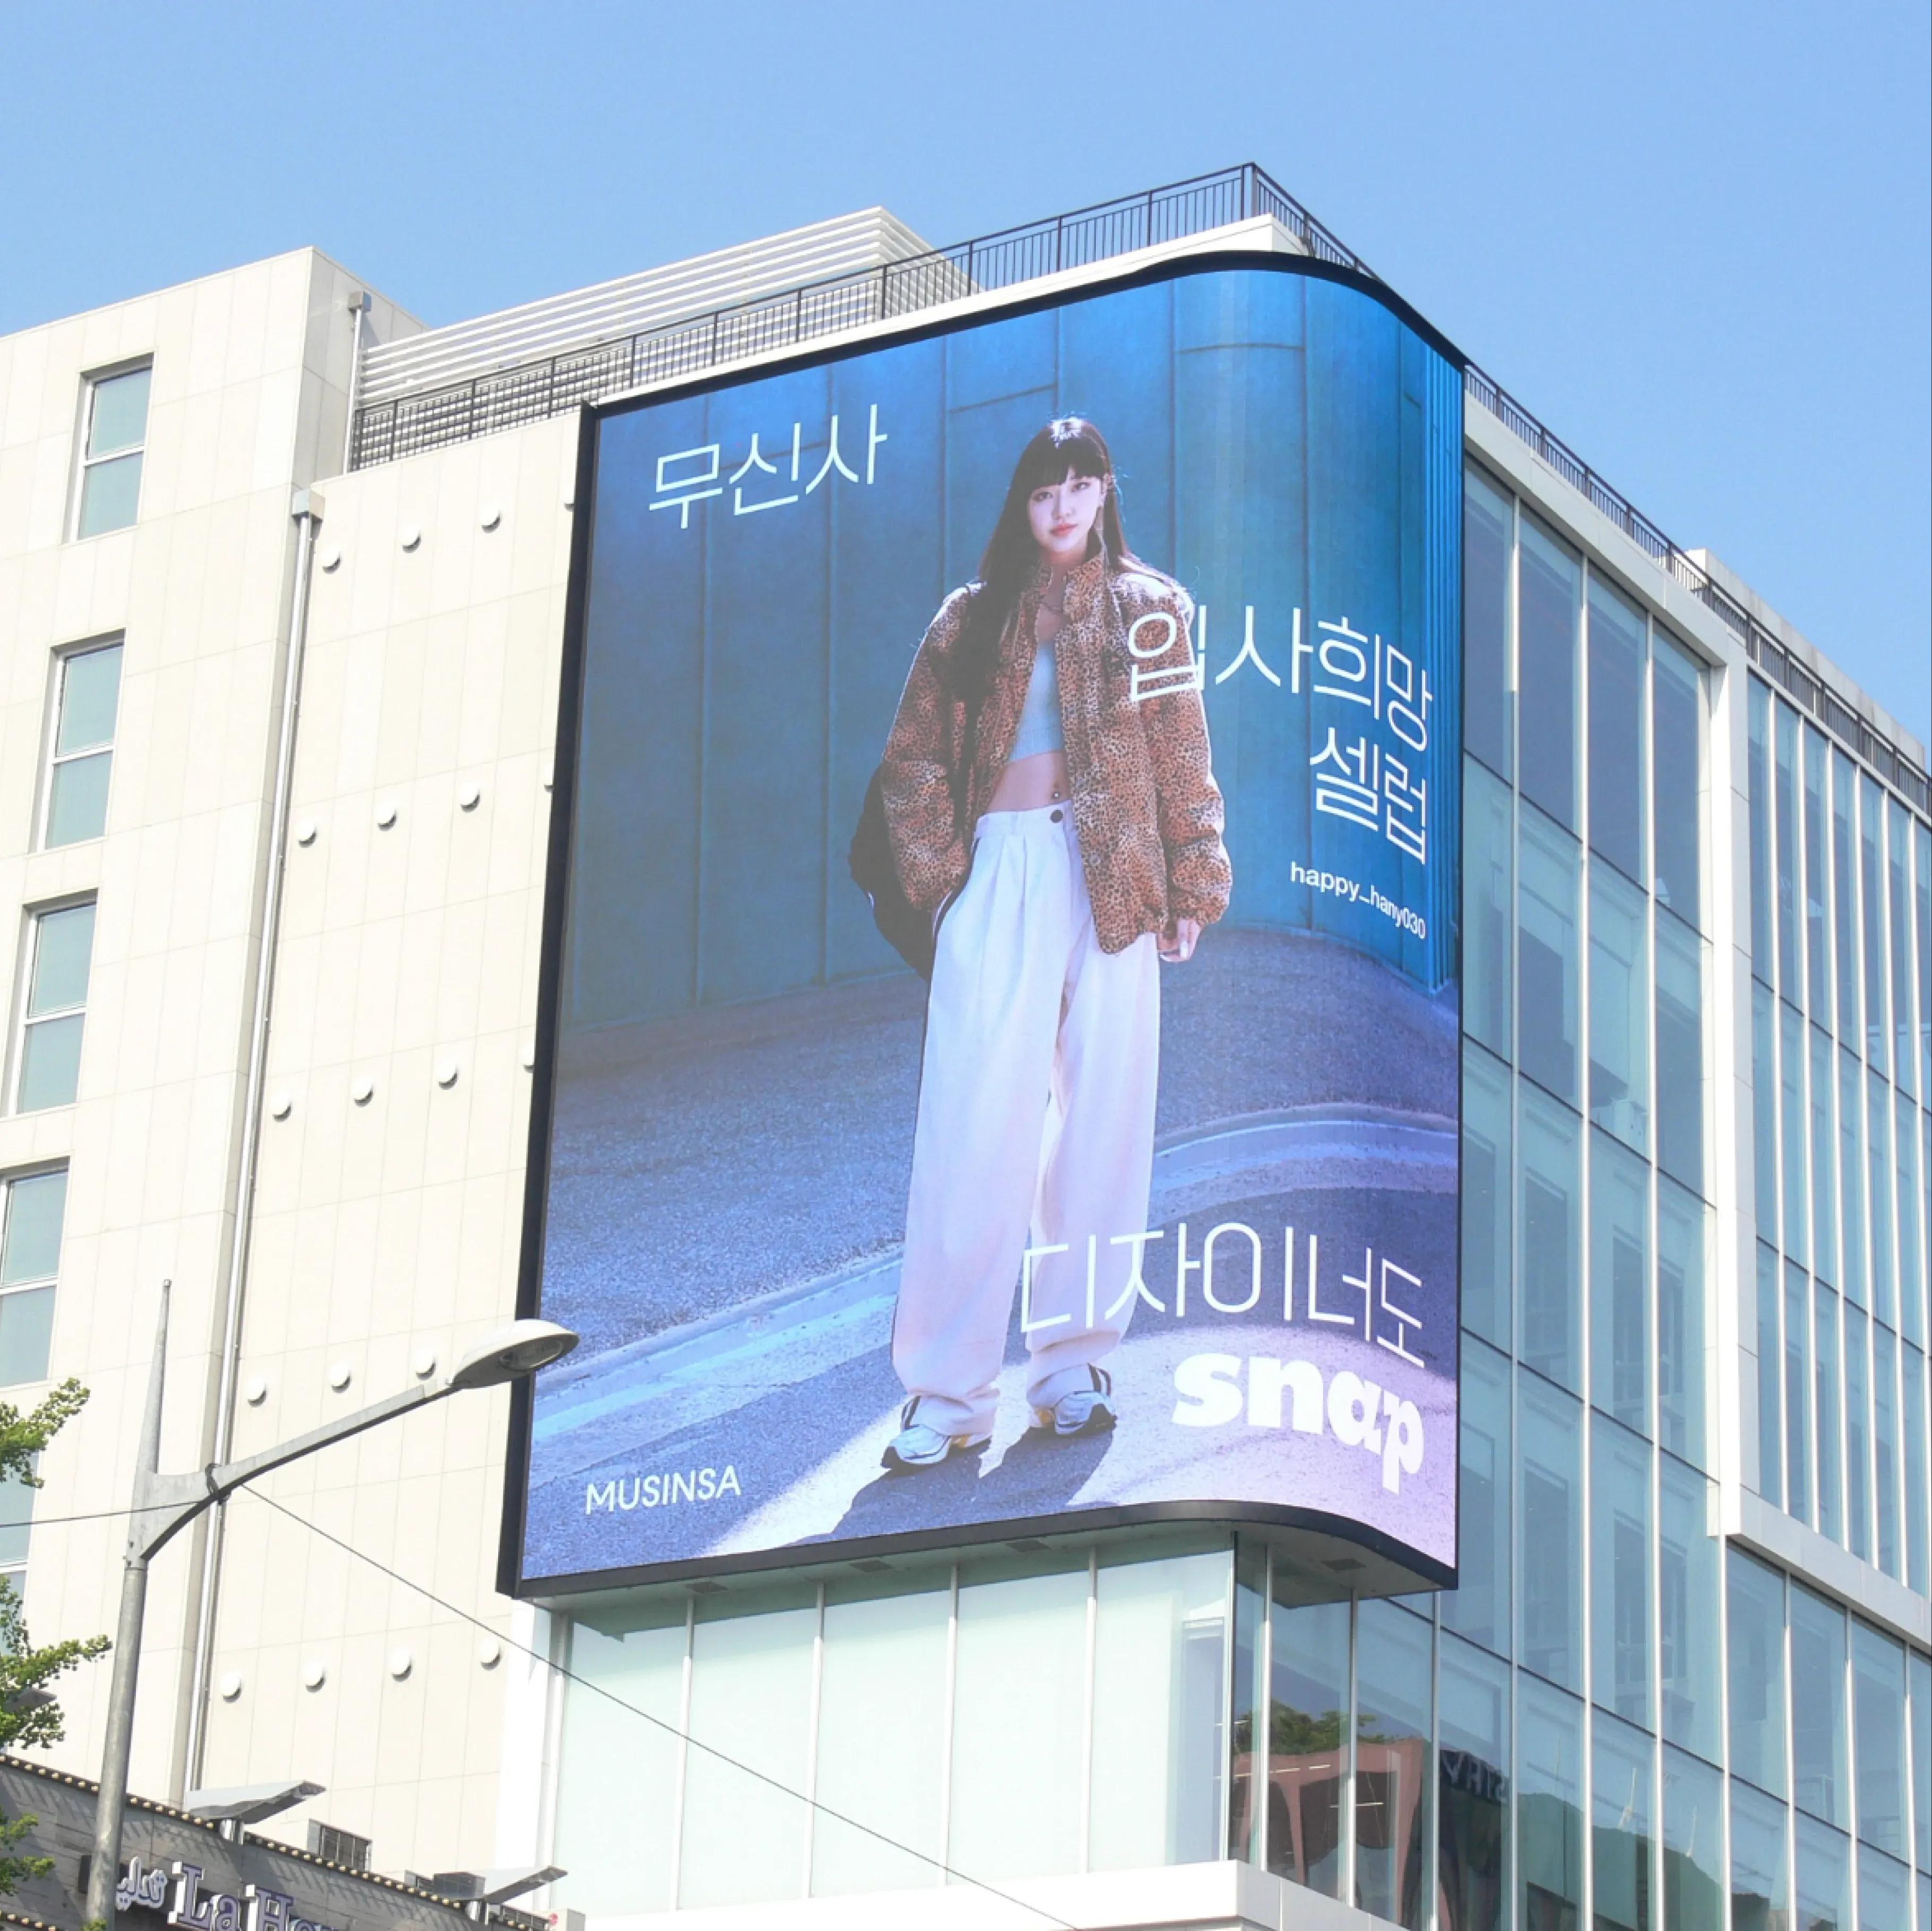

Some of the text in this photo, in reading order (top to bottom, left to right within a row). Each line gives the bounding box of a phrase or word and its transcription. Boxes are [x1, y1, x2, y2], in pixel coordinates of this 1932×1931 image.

[649, 404, 888, 529] 무신사
[1309, 727, 1426, 865] 셀럽
[1290, 860, 1426, 939] happy_hany030
[1020, 1223, 1425, 1369] 디자이너도
[1171, 1353, 1425, 1496] snap
[585, 1465, 742, 1515] MUSINSA
[167, 1861, 241, 1931] La
